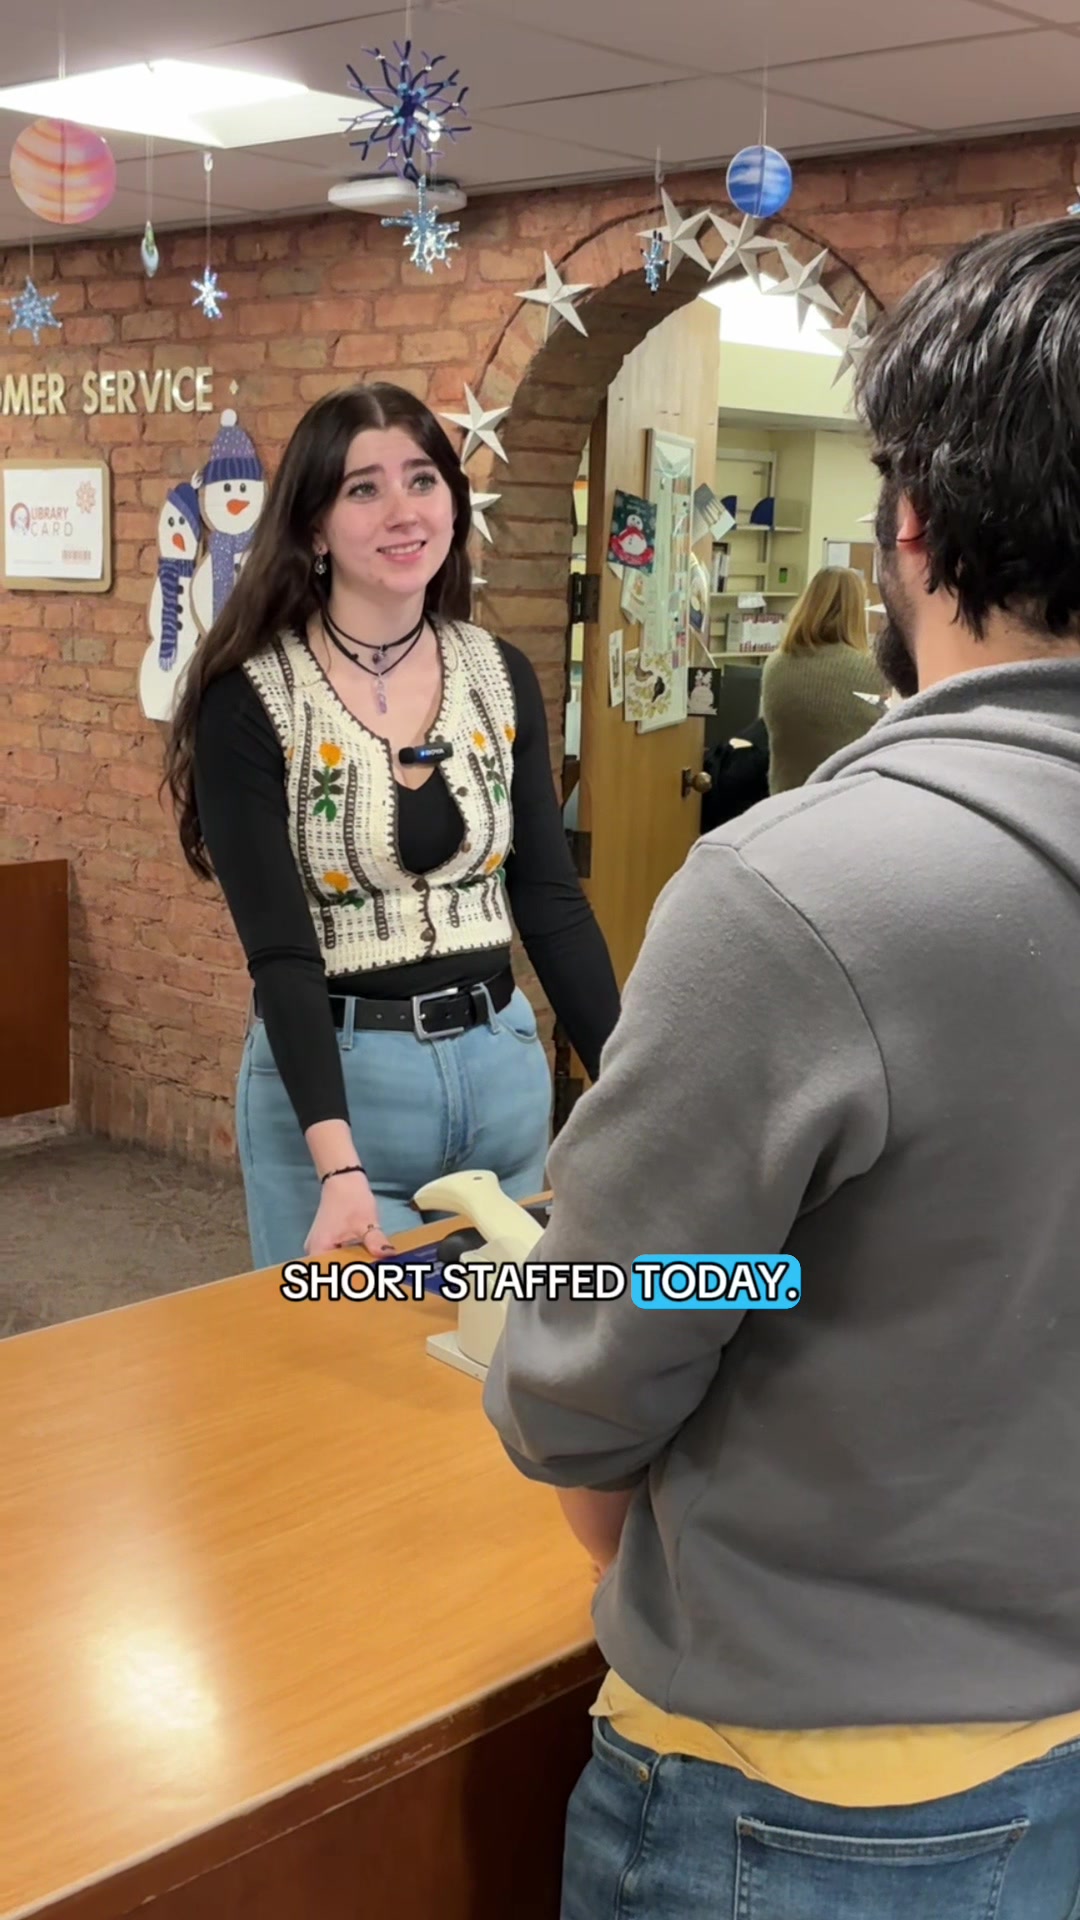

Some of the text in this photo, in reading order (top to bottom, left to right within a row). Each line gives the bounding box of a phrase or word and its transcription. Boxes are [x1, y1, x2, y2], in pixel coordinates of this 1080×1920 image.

[0, 366, 213, 415] MER SERVICE
[31, 506, 69, 520] LIBRARY
[30, 521, 73, 537] CARD
